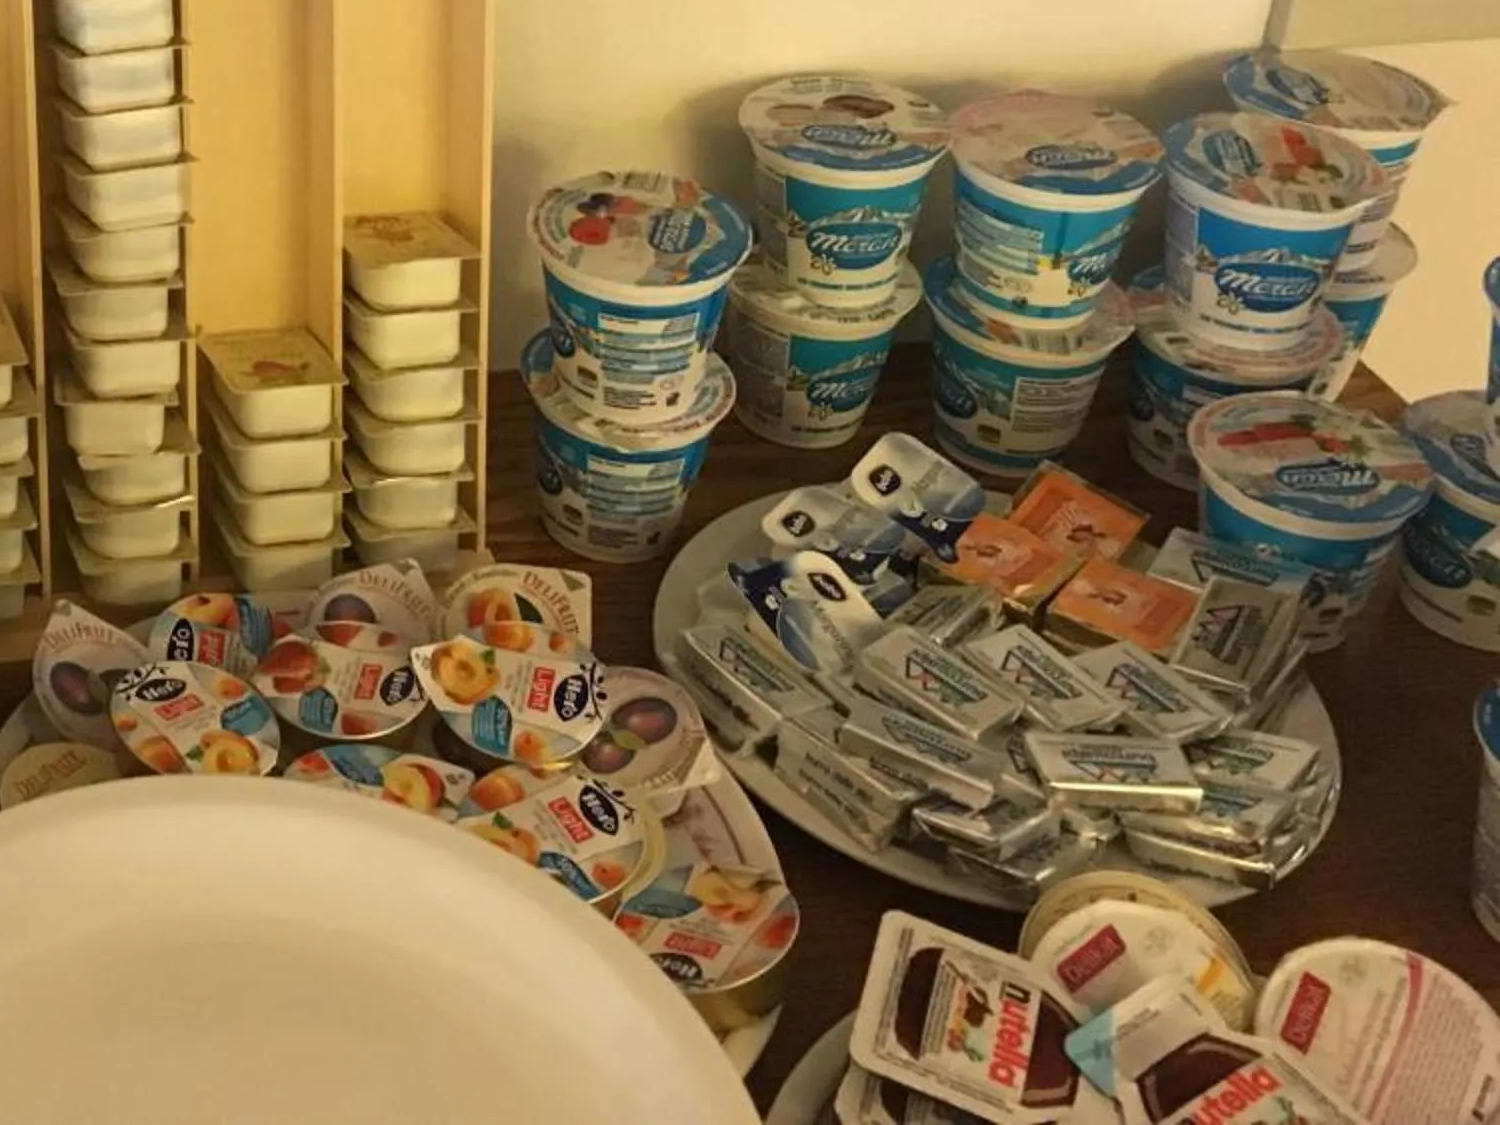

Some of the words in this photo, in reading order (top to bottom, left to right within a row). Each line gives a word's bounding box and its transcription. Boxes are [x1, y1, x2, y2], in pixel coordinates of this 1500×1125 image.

[170, 627, 193, 662] ero
[144, 681, 184, 700] Hero
[561, 678, 584, 717] Hero
[581, 791, 617, 832] Hero
[988, 981, 1031, 1087] nutella
